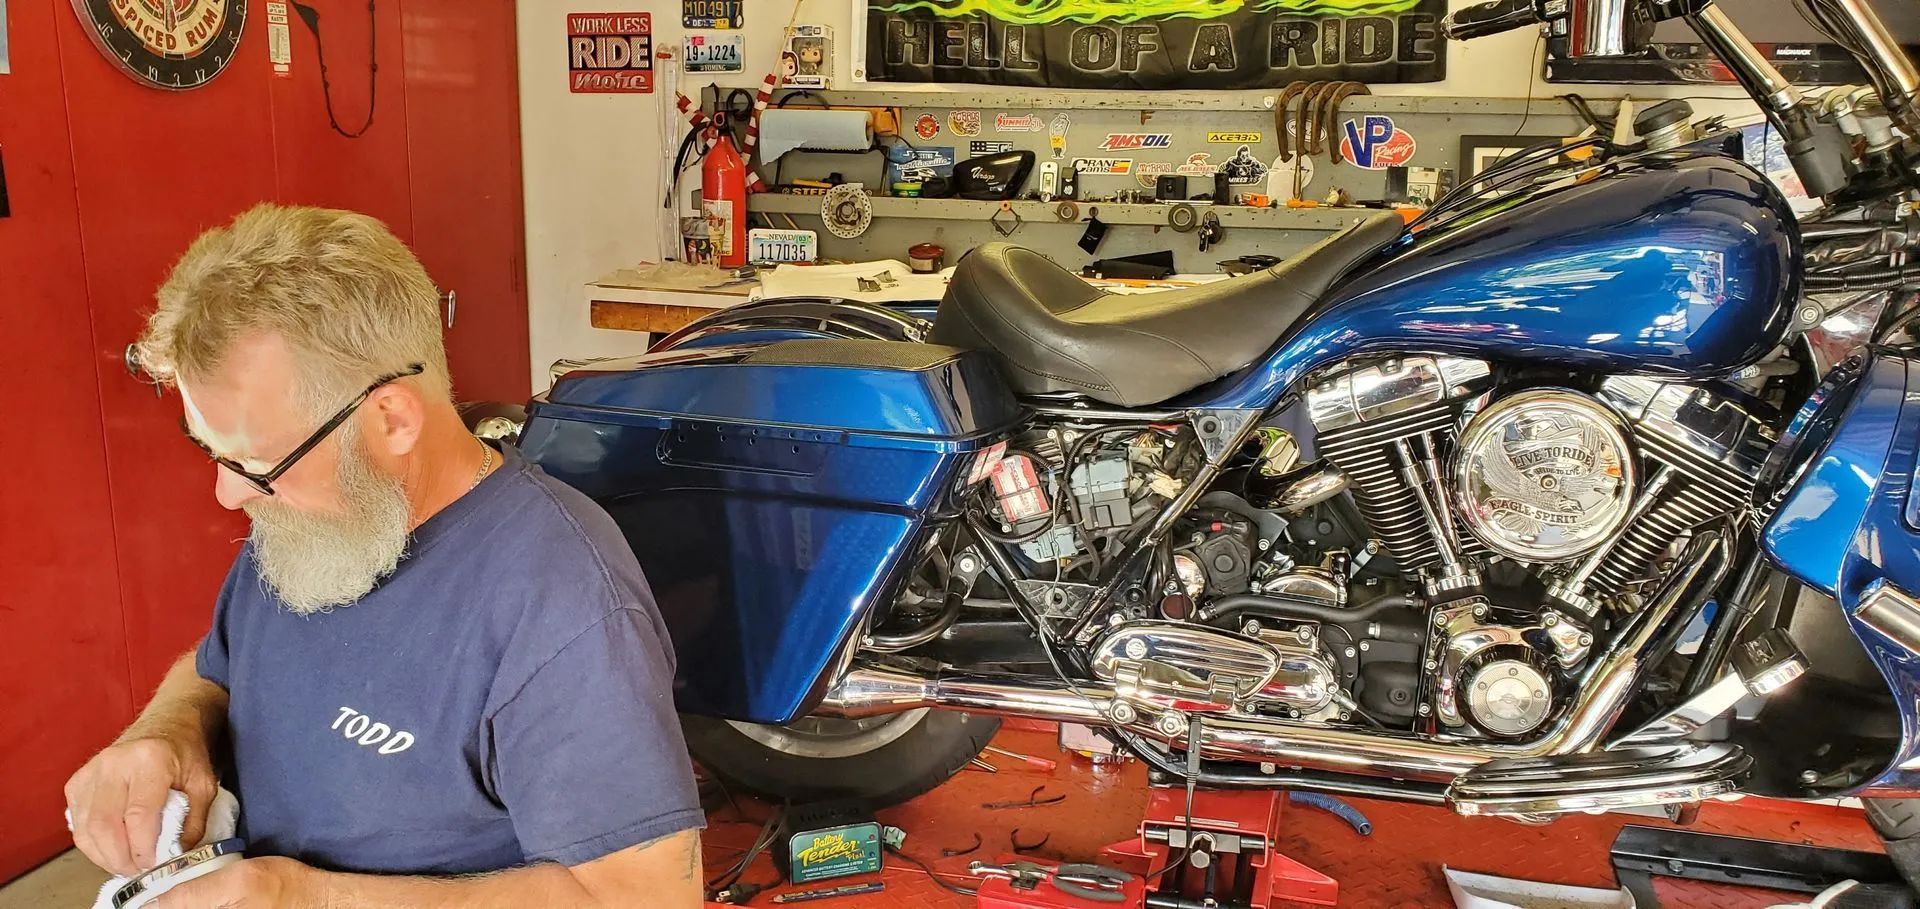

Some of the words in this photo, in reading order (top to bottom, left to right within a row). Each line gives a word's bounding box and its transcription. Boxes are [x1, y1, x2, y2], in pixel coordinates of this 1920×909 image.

[185, 8, 218, 48] RUM
[572, 18, 614, 33] WORK
[617, 17, 649, 32] LESS
[572, 37, 649, 68] RIDE
[886, 20, 1040, 71] HELL
[1070, 24, 1159, 73] OF
[1188, 23, 1237, 72] A
[1269, 14, 1436, 69] RIDE
[1102, 134, 1170, 149] AMSOIL
[1344, 115, 1394, 168] VP
[1375, 143, 1413, 161] Racing
[759, 243, 806, 261] 117035
[1513, 450, 1542, 468] LIVE
[1544, 447, 1560, 458] TO
[1562, 447, 1593, 466] RIDE
[331, 706, 415, 755] TODD
[797, 840, 857, 867] Tender
[813, 833, 844, 850] Battery
